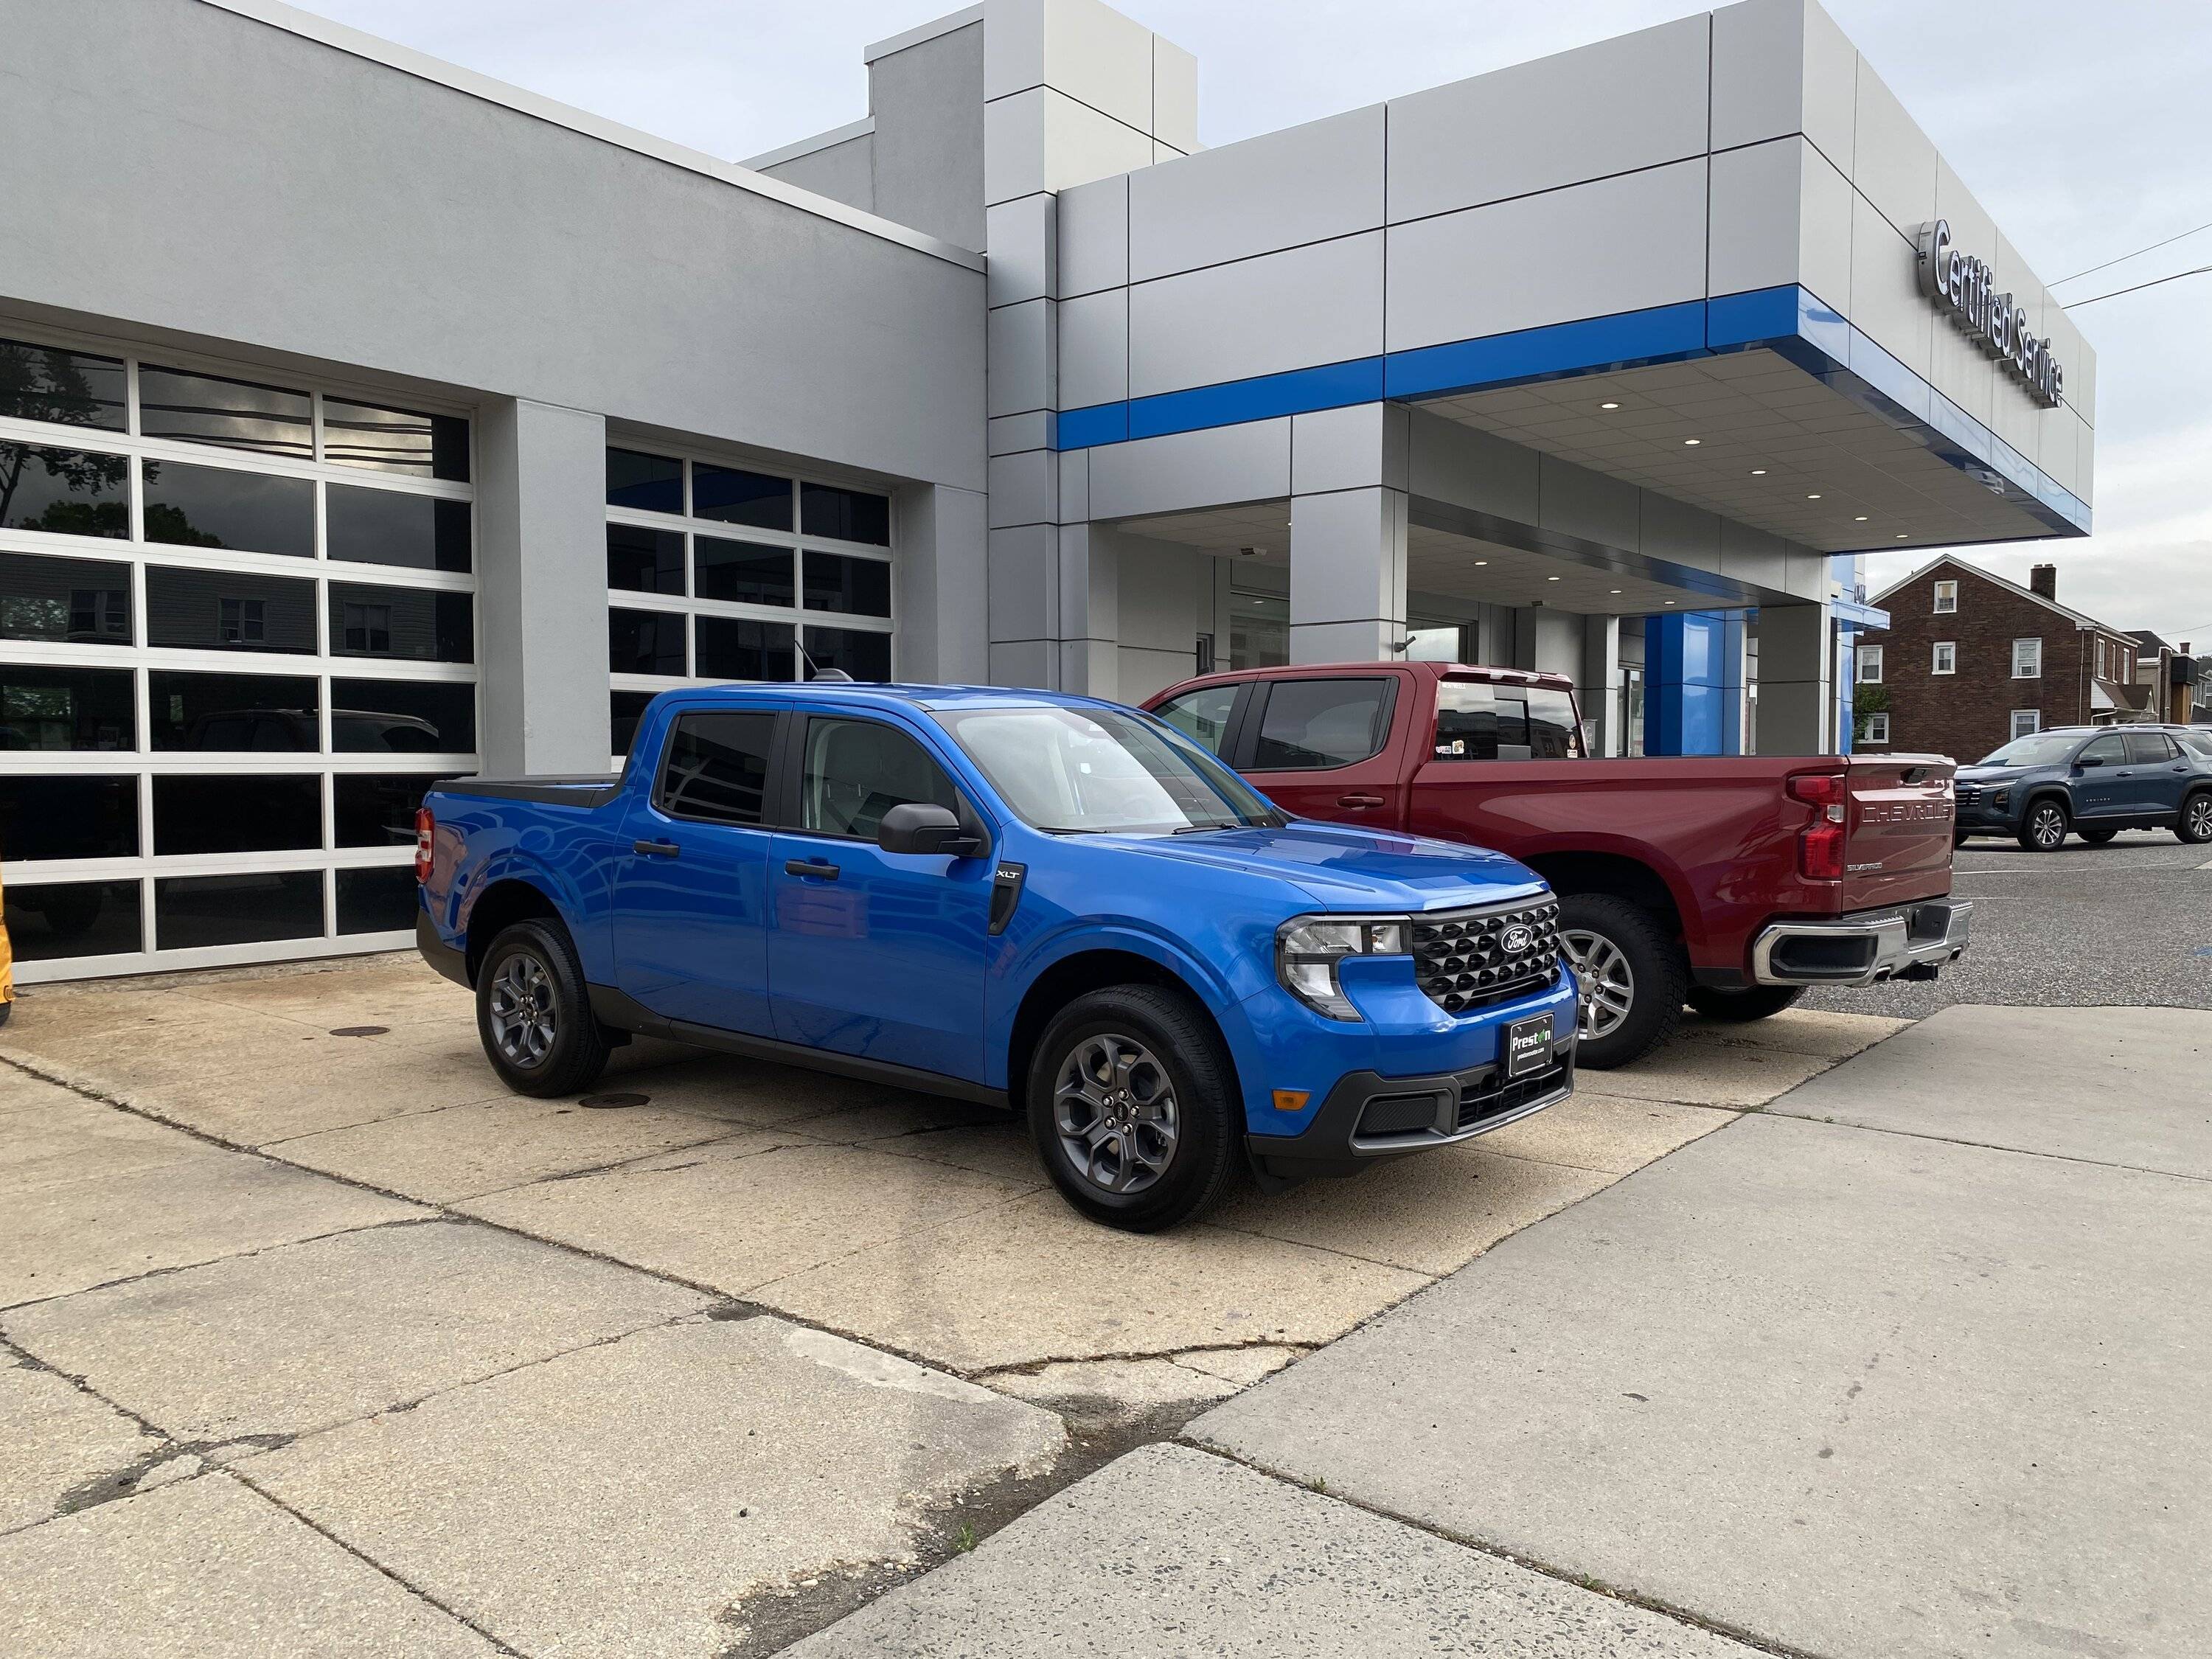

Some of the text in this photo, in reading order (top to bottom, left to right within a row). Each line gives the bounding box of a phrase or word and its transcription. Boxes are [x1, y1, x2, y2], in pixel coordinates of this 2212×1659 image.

[1929, 219, 2063, 408] Certified Service
[1863, 803, 1955, 822] CHEVROLET
[996, 870, 1020, 879] XLT
[1508, 930, 1528, 950] Ford
